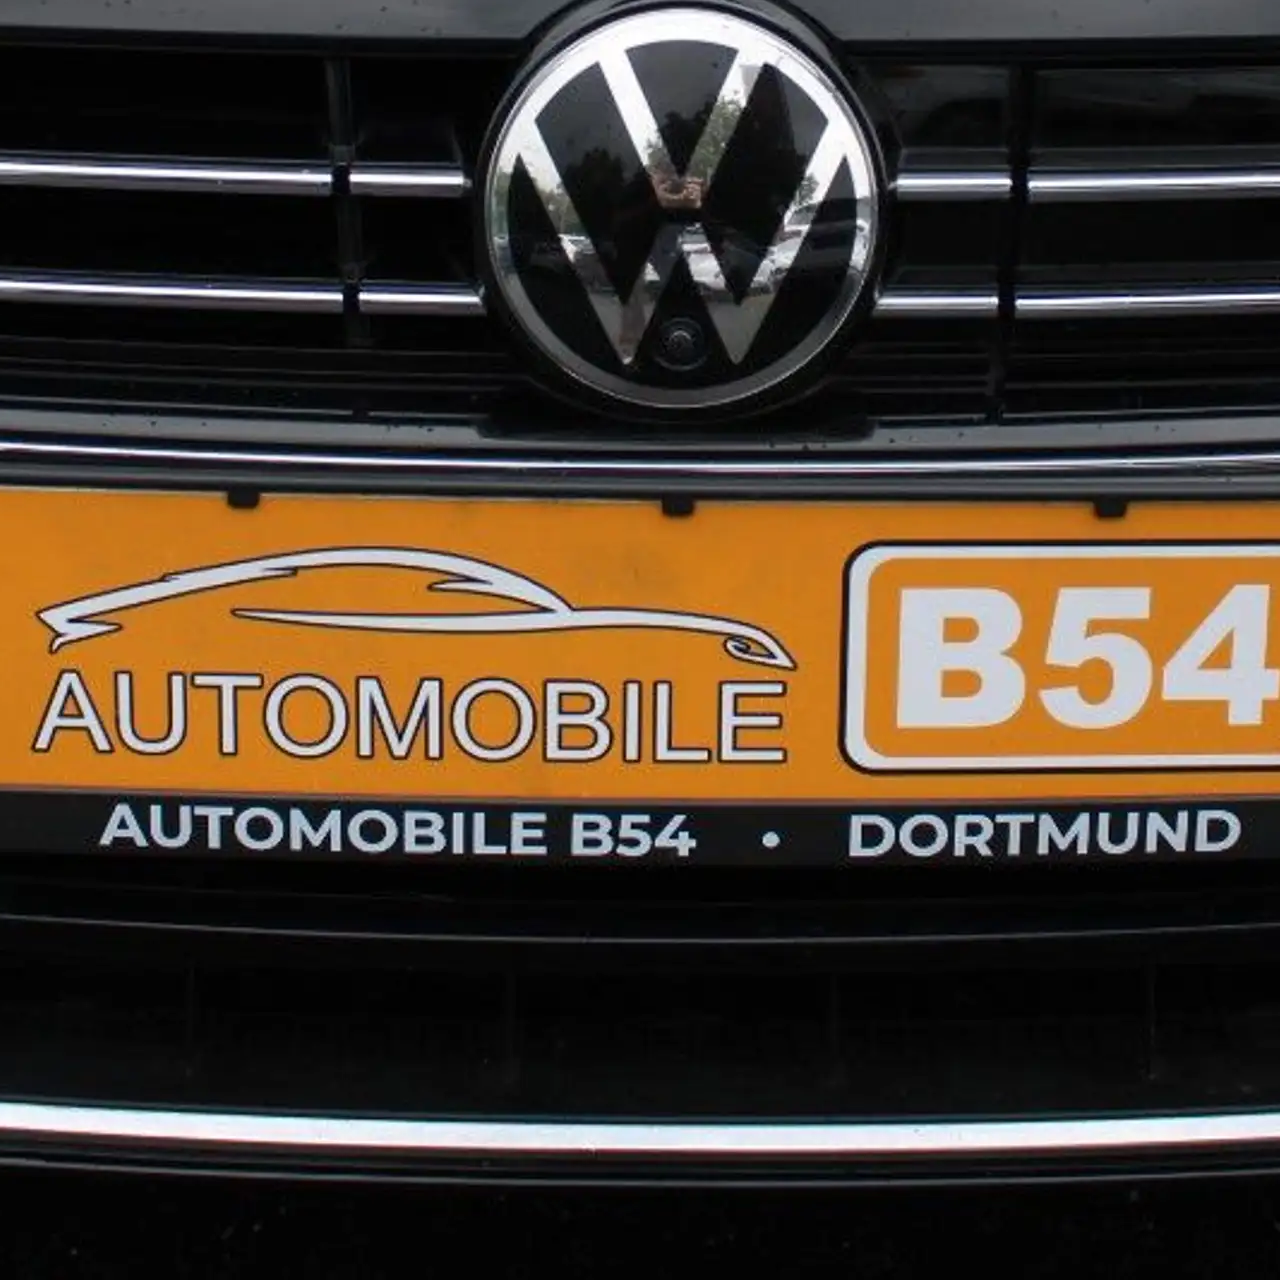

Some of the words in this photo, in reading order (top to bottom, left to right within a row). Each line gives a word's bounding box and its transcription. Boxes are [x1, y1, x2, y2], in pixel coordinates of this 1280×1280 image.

[498, 18, 865, 382] VW
[32, 669, 787, 764] AUTOMOBILE
[99, 803, 547, 856] AUTOMOBILE
[571, 812, 697, 857] B54
[849, 809, 1242, 857] DORTMUND
